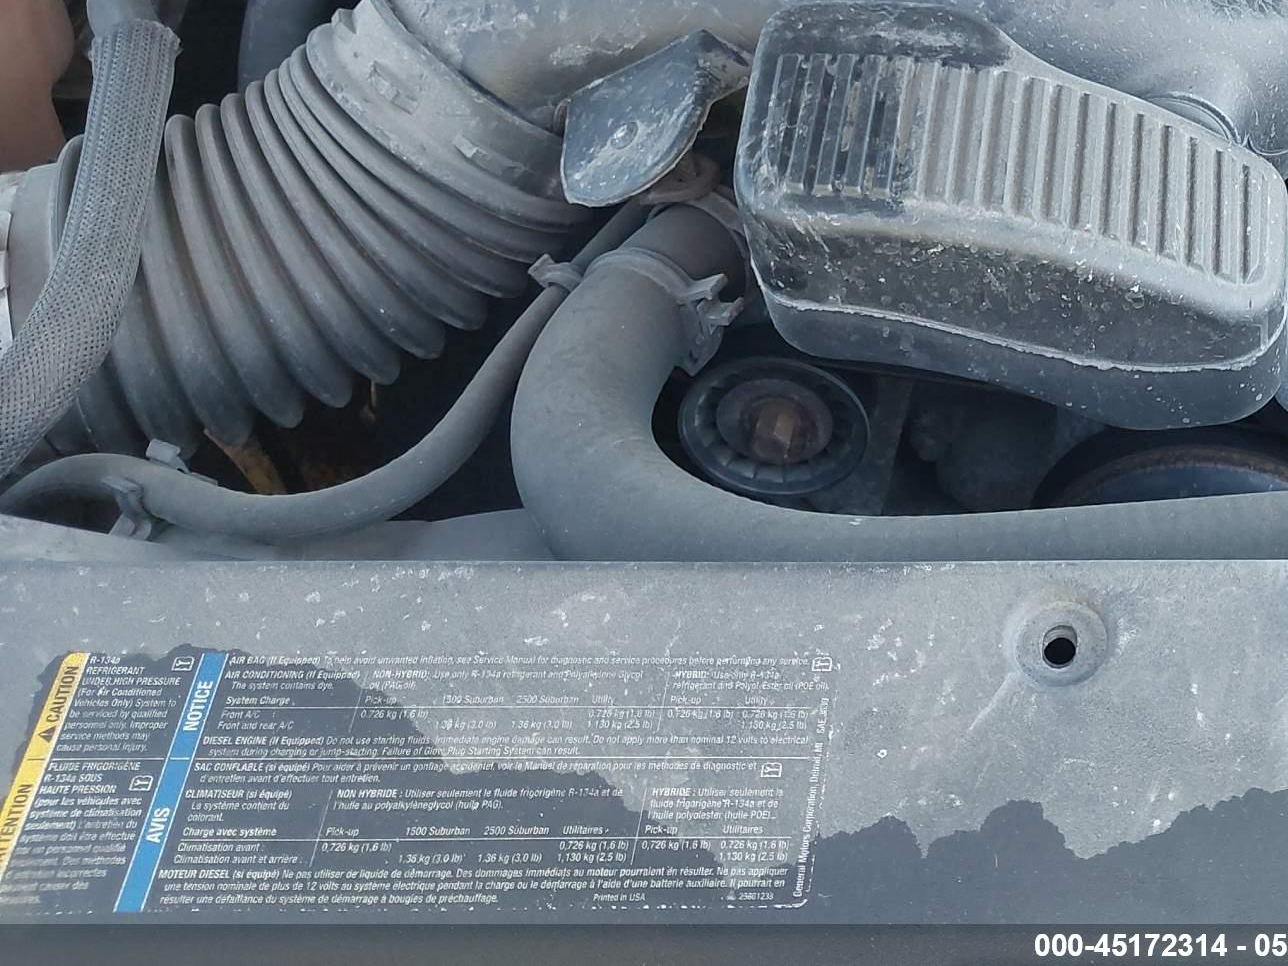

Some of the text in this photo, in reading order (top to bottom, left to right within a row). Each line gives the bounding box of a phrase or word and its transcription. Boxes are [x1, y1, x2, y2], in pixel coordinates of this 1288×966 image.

[48, 666, 79, 722] CAUTION
[183, 681, 213, 731] NOTICE
[146, 807, 171, 844] AVIS
[306, 883, 316, 891] 12
[793, 865, 806, 898] General
